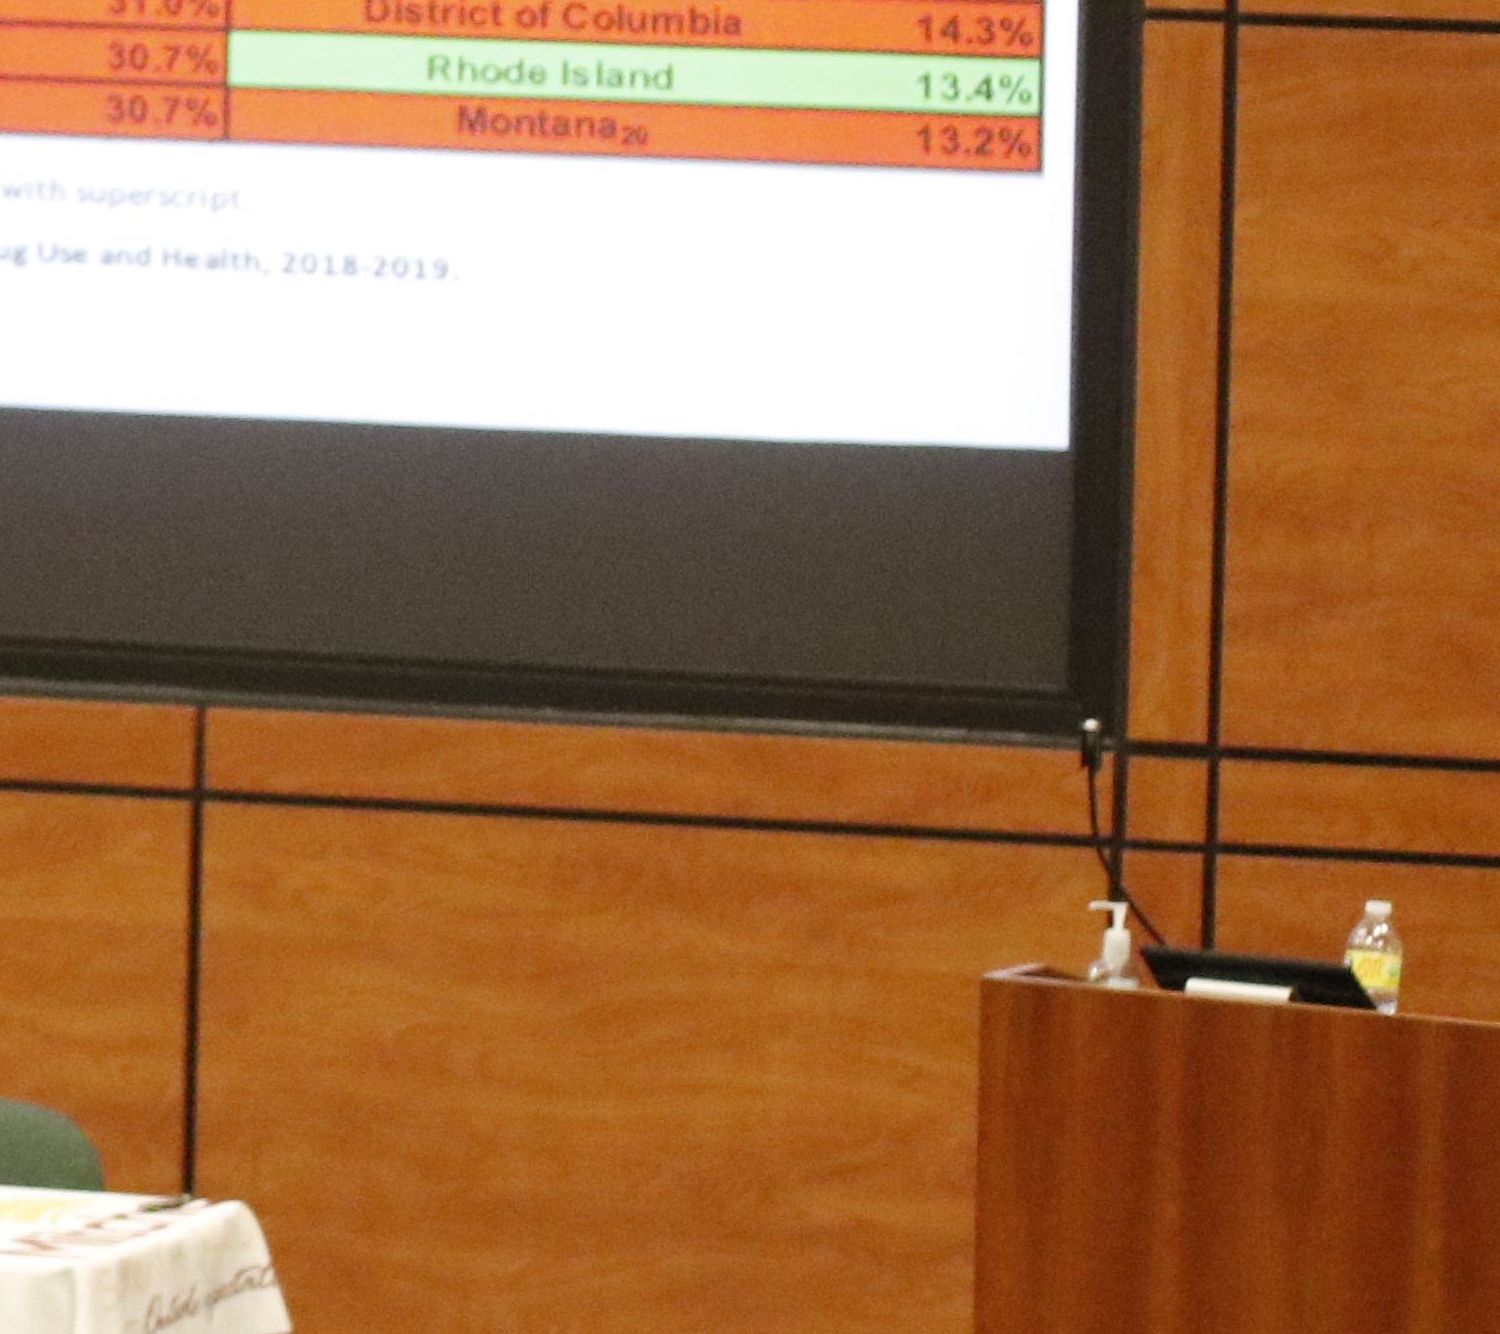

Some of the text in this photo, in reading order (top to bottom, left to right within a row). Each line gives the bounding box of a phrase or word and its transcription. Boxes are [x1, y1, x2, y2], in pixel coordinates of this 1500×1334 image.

[514, 0, 550, 30] of
[560, 0, 744, 39] Columbia
[915, 15, 1035, 49] 14.3%
[107, 42, 219, 74] 30.7%
[426, 52, 1033, 105] Rhode Island 13.4%
[106, 94, 218, 127] 30.7%
[913, 124, 1033, 159] 13.2%
[0, 175, 68, 203] with
[37, 240, 90, 266] Use
[98, 242, 153, 269] and
[160, 244, 271, 279] Health,
